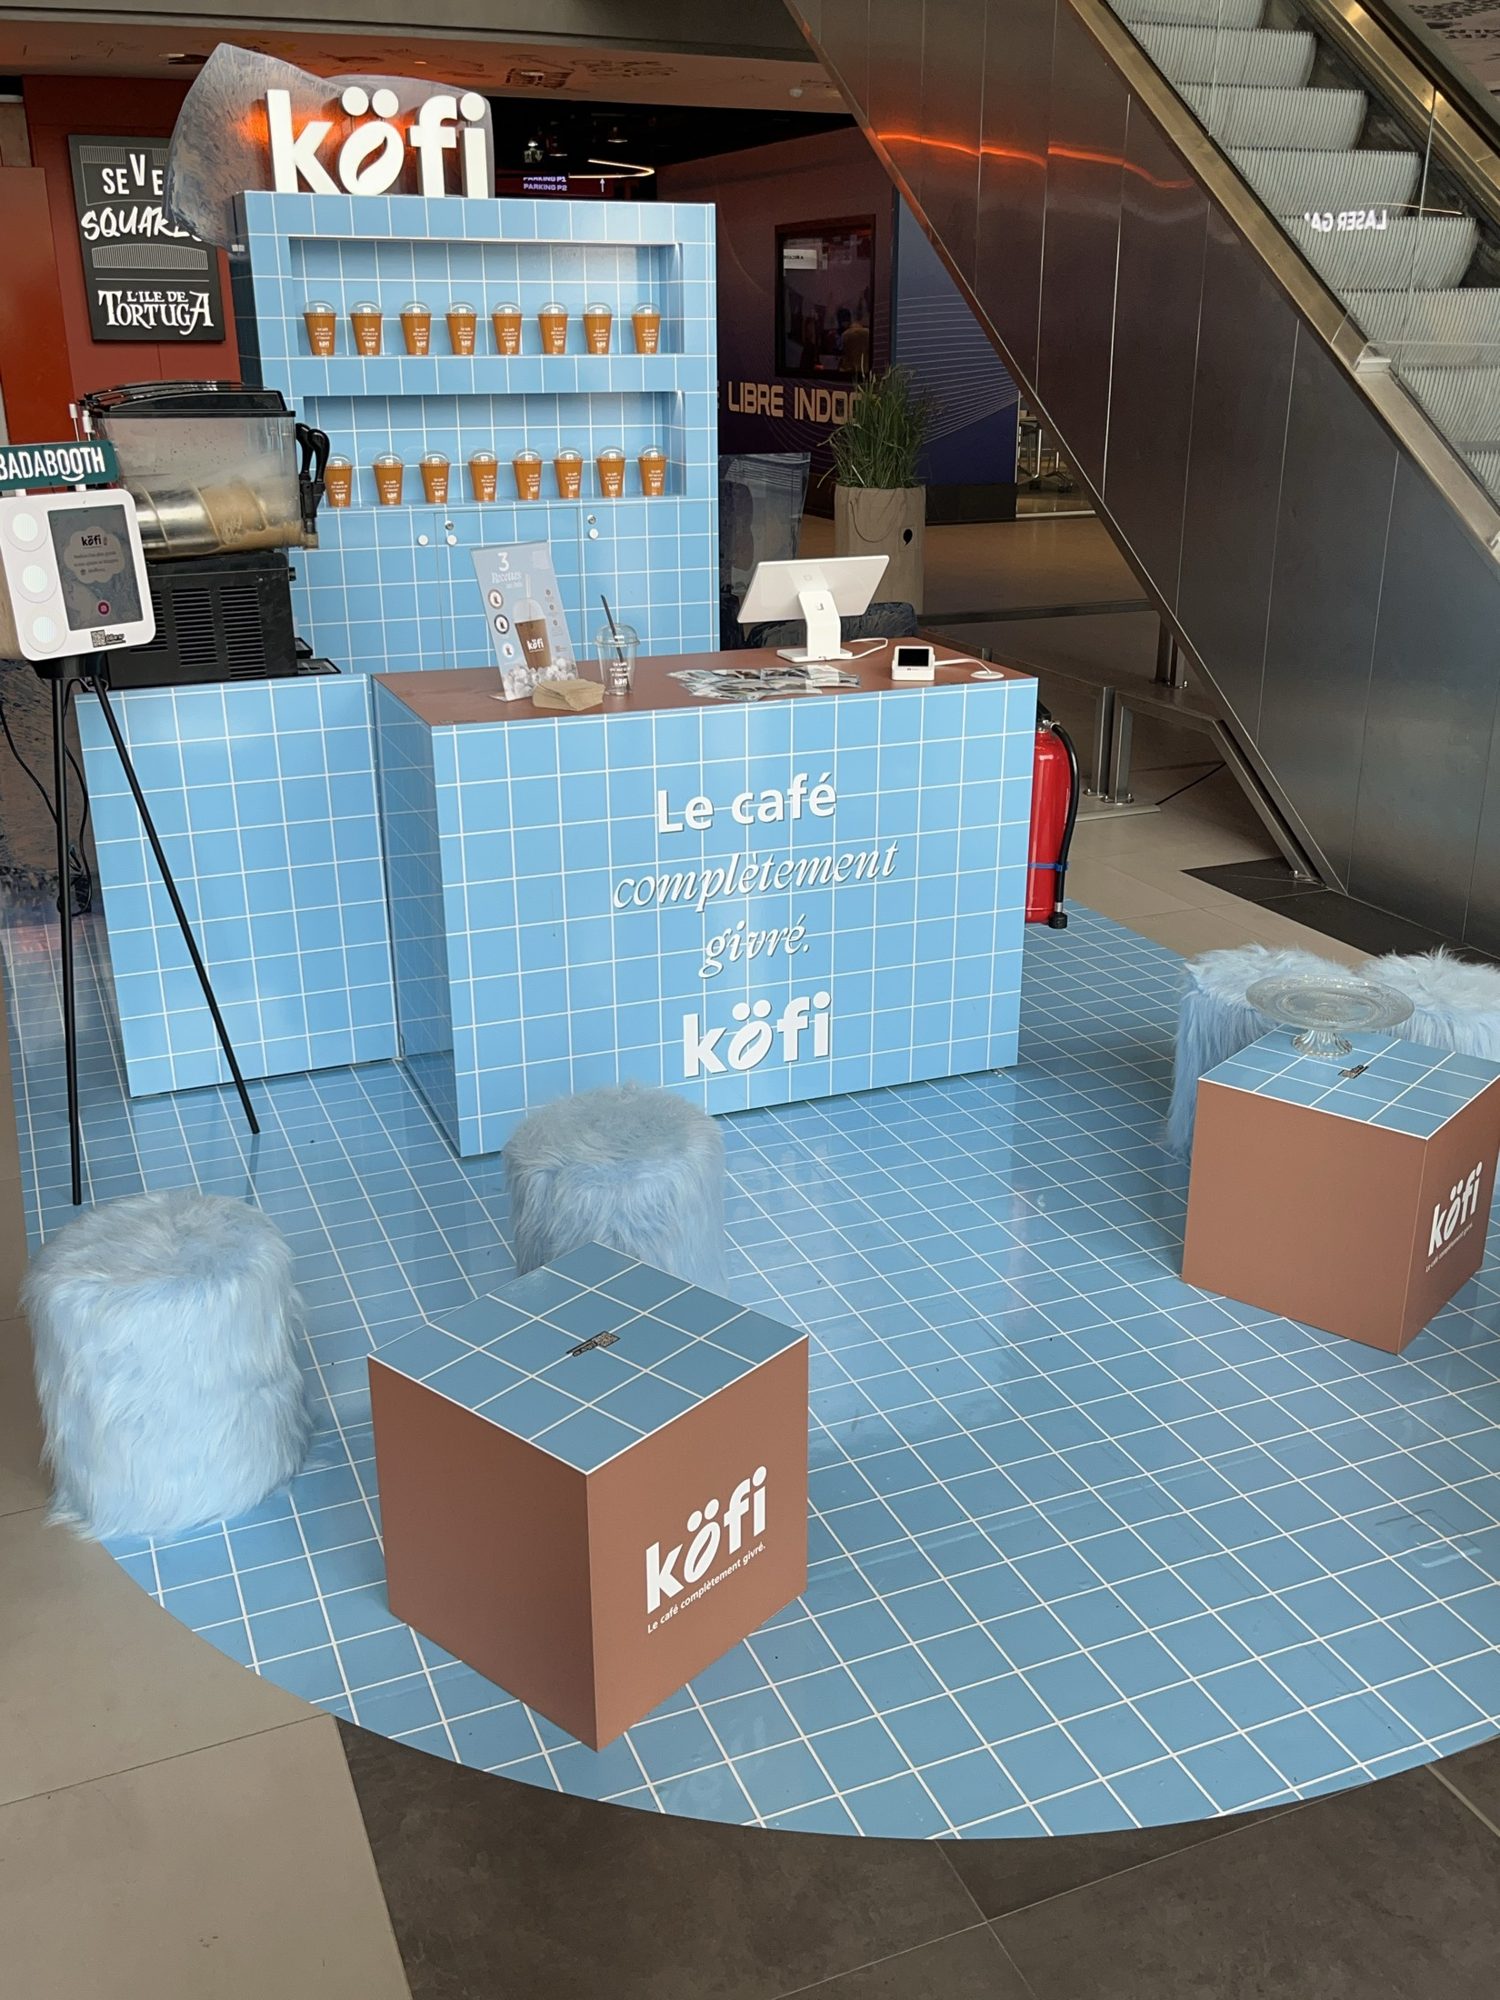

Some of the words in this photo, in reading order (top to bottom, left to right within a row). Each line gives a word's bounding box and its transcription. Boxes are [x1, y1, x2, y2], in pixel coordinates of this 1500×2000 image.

[266, 86, 489, 198] köfi
[102, 153, 164, 195] SEVE
[81, 205, 203, 242] SQUAR
[98, 289, 214, 335] TORTUGA
[126, 290, 165, 302] L'ILE
[166, 290, 189, 302] DE
[727, 381, 784, 418] LIBRE
[0, 446, 106, 481] BADABOOTH
[497, 551, 510, 572] 3
[657, 789, 714, 833] Le
[731, 772, 837, 824] café
[613, 840, 899, 912] complètement
[698, 913, 810, 979] givré.
[683, 991, 832, 1078] köfi
[1428, 1161, 1483, 1257] köfi
[646, 1465, 767, 1614] köfi
[647, 1621, 659, 1634] Le
[660, 1603, 679, 1624] café
[680, 1559, 741, 1609] complètement
[742, 1542, 766, 1565] givré.
